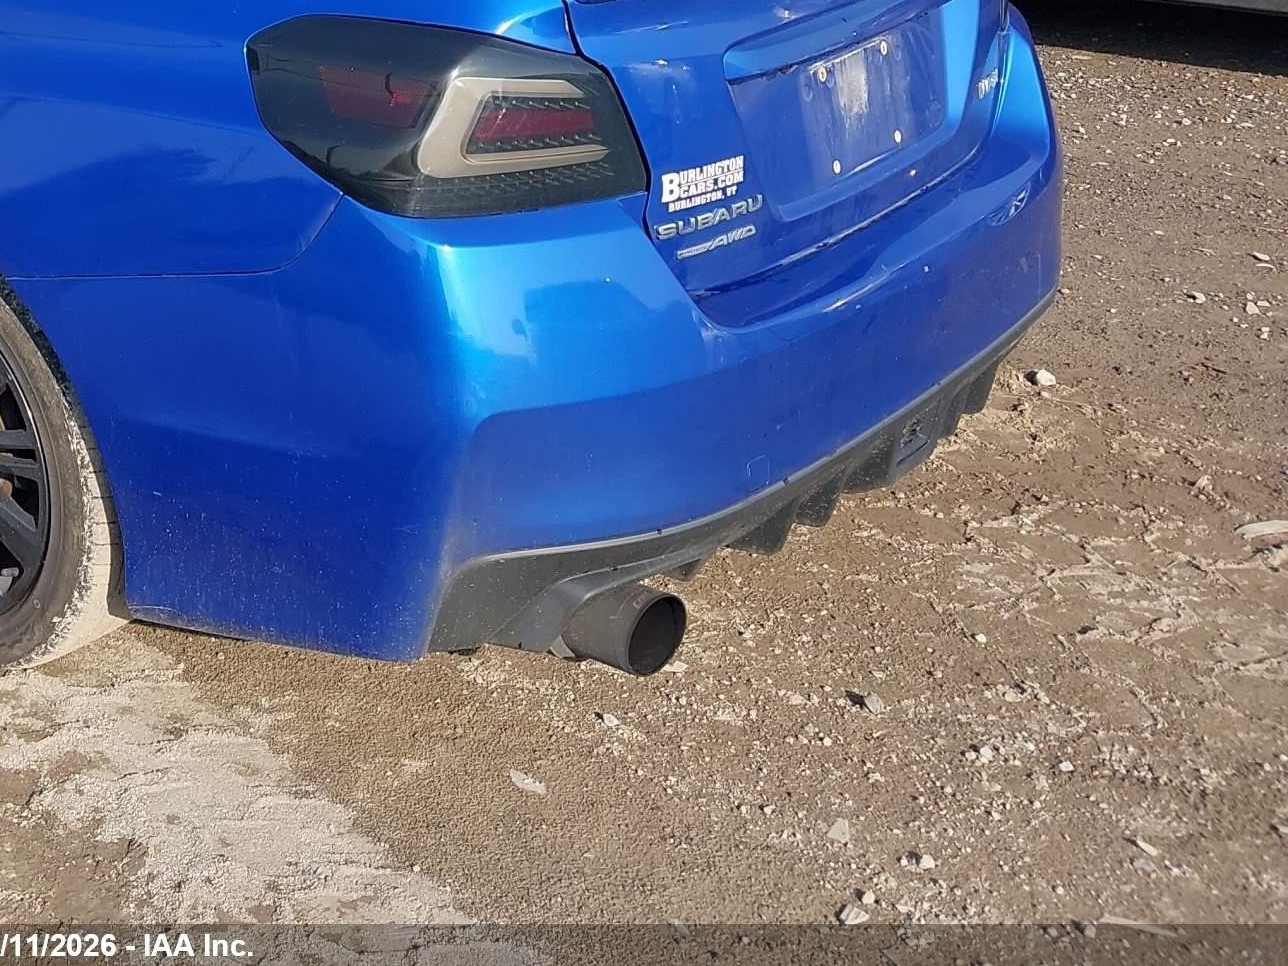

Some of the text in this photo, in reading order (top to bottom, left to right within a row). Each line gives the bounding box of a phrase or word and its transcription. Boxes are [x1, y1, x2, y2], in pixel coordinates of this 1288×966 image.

[661, 155, 744, 203] BURLINGTON
[680, 170, 744, 199] CARS.COM
[668, 186, 737, 213] BURLINGTON, VT
[656, 194, 763, 241] SUBARU
[708, 225, 757, 251] AWD
